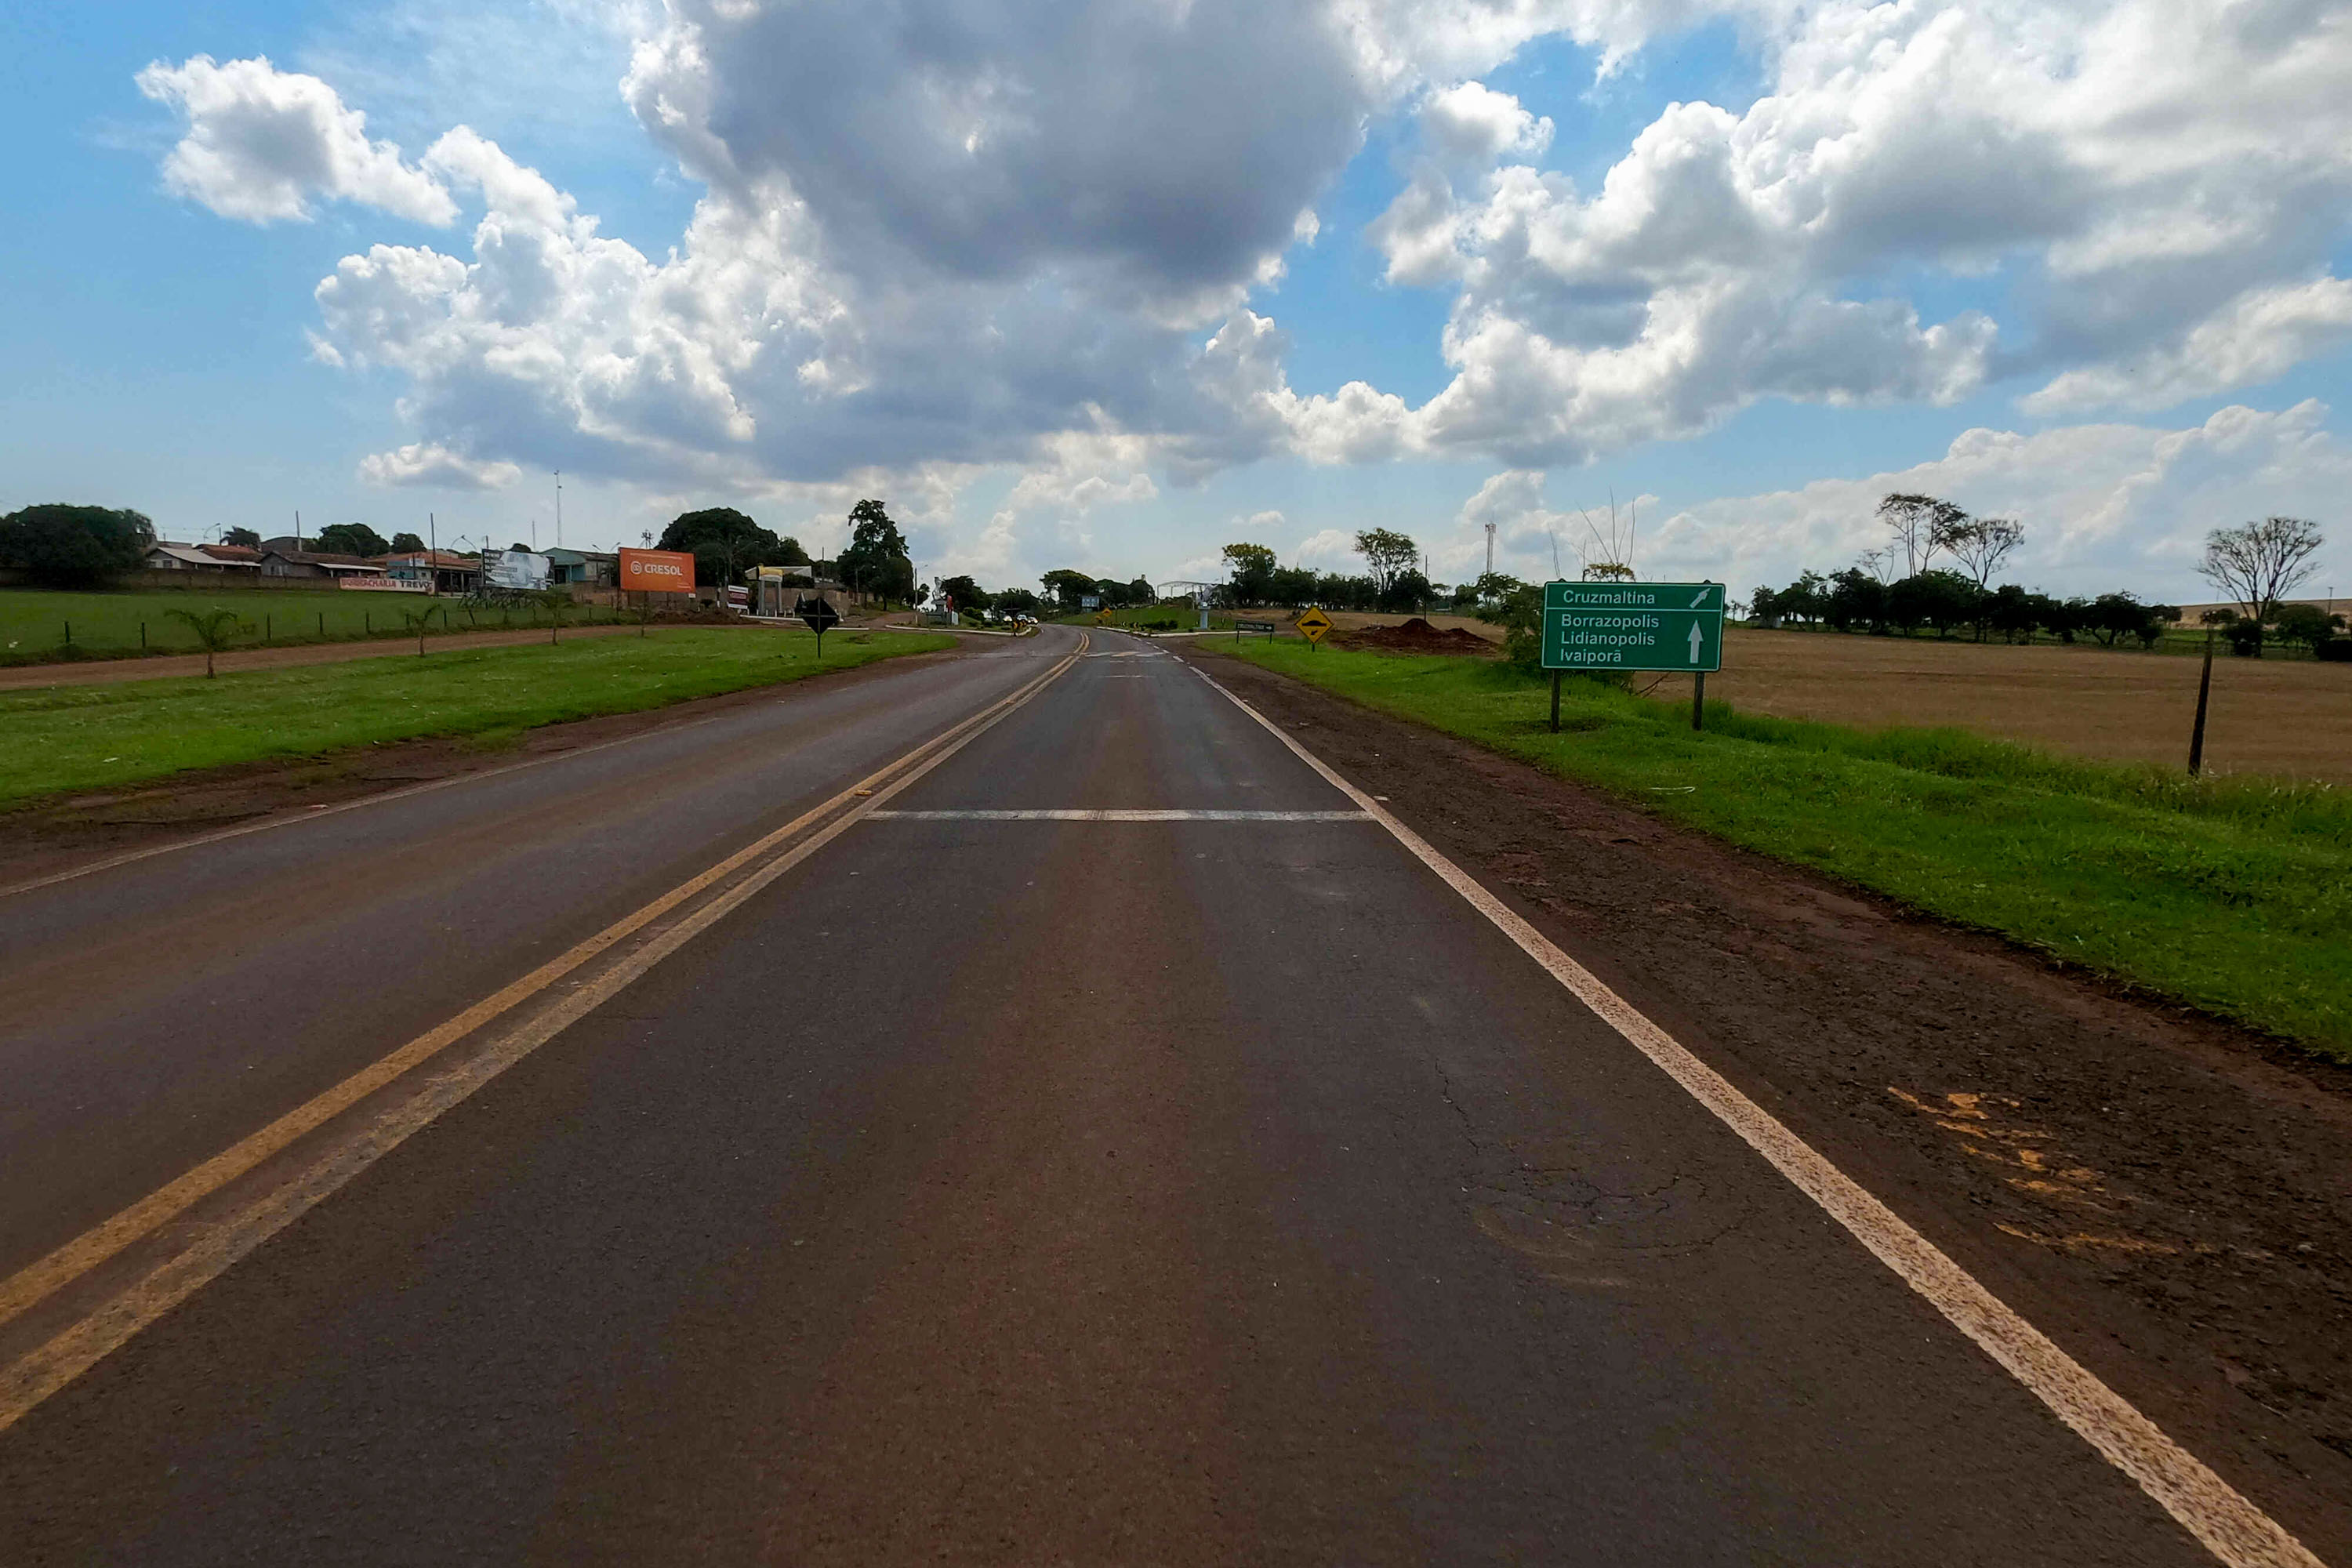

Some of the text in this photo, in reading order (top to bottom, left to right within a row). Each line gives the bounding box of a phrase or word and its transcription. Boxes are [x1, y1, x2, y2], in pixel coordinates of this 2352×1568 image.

[644, 564, 683, 575] CRESOL
[1563, 590, 1656, 604] Cruzmaltina
[1561, 614, 1660, 630] Borrazopolis
[1561, 631, 1656, 647] Lidianopolis
[1560, 648, 1622, 665] Ivaiporã
